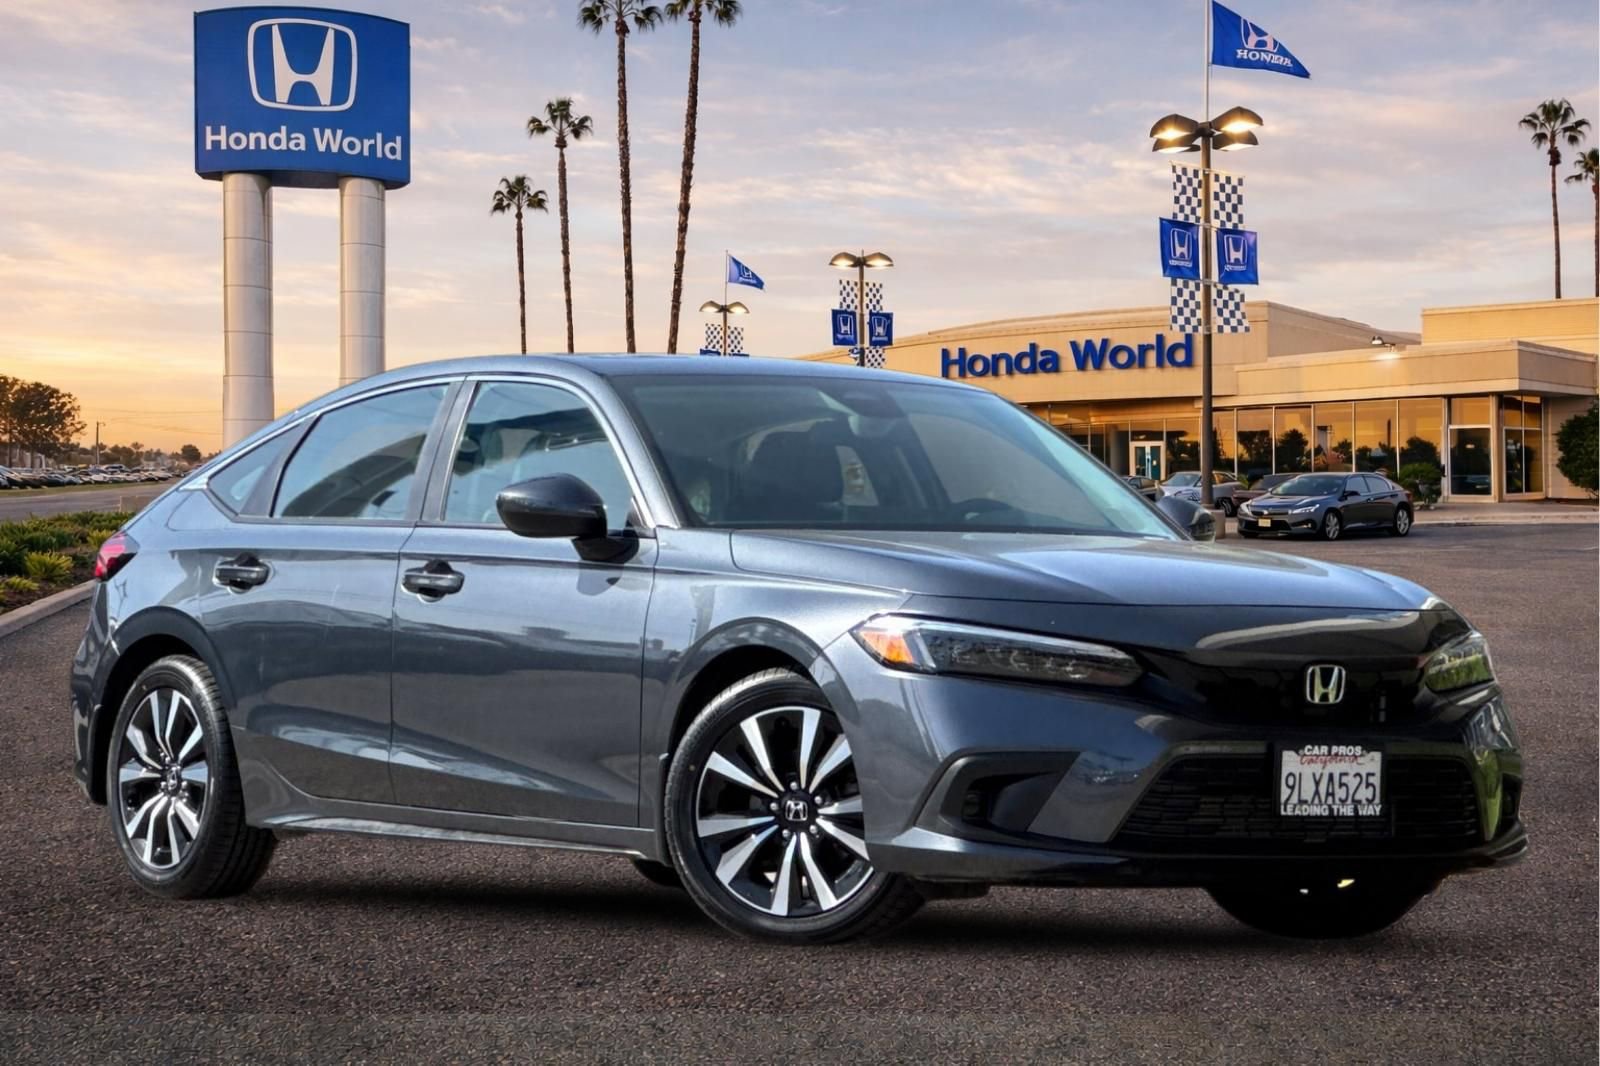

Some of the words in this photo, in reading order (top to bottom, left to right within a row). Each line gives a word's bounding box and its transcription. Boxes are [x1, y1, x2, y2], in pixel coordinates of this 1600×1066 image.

[205, 125, 306, 151] Honda
[313, 127, 402, 161] World
[941, 342, 1061, 378] Honda
[1069, 333, 1195, 372] World
[1304, 745, 1328, 755] CAR
[1331, 745, 1362, 756] PROS
[1285, 771, 1376, 804] 9LXA525
[1281, 804, 1329, 816] LEADING
[1332, 804, 1355, 816] THE
[1358, 804, 1382, 816] WAY
